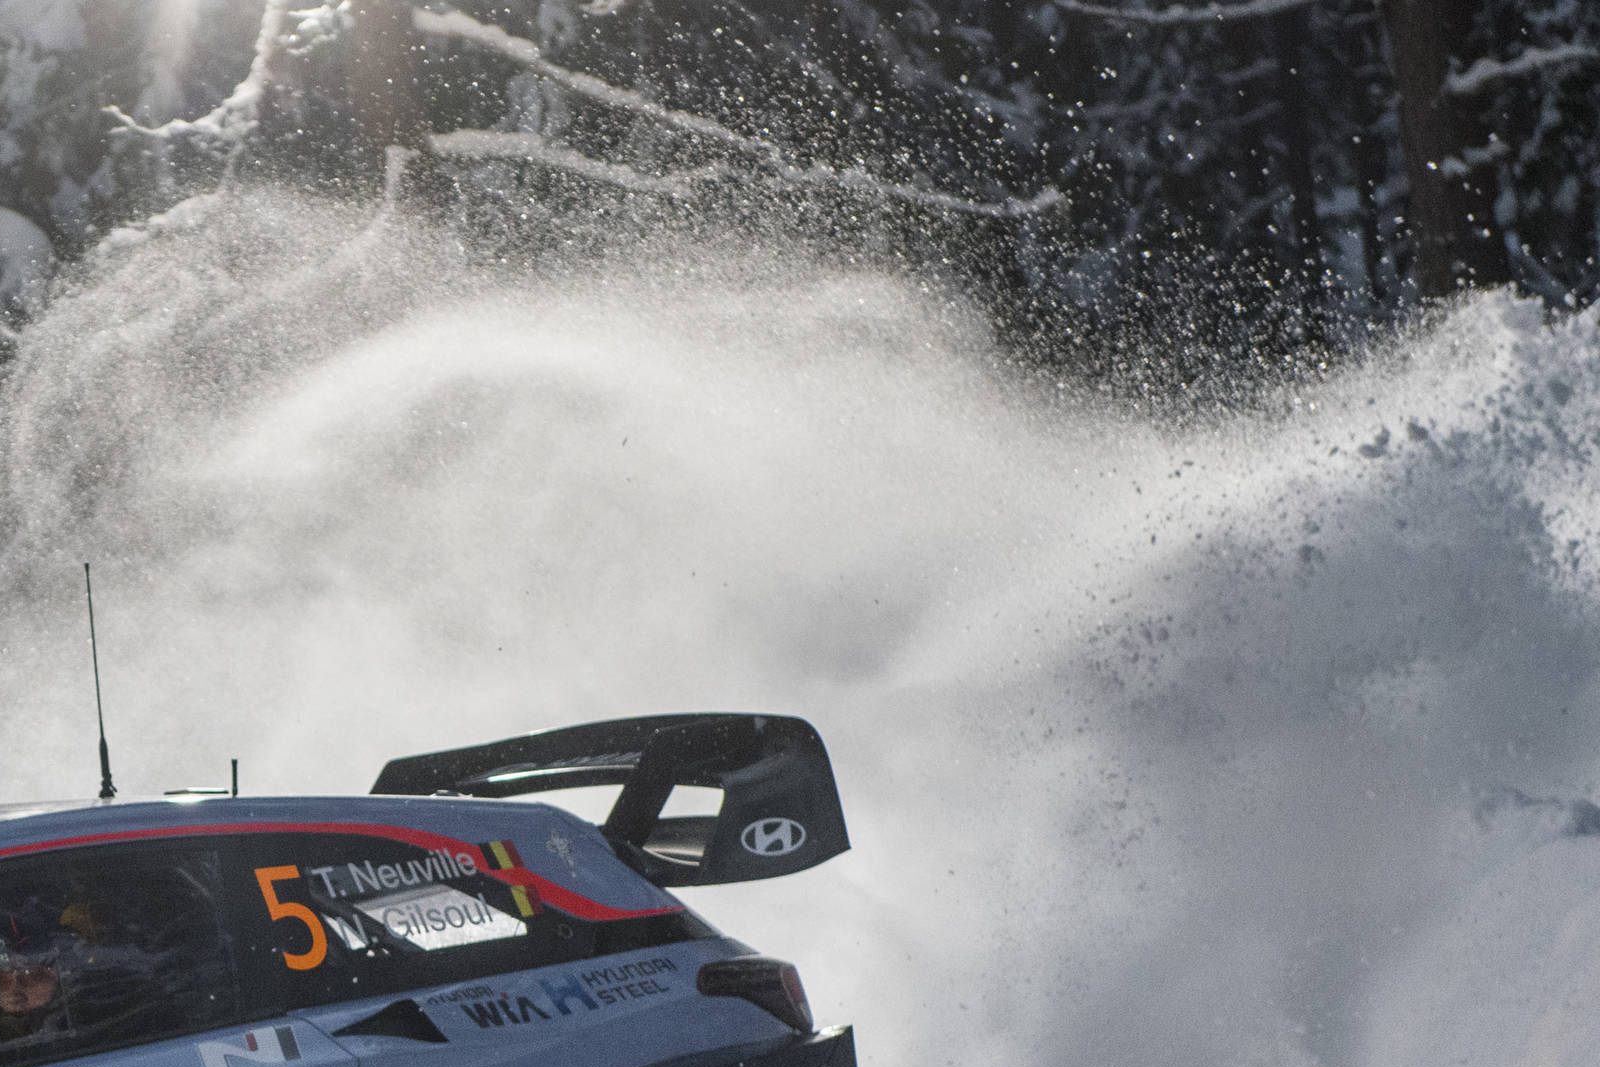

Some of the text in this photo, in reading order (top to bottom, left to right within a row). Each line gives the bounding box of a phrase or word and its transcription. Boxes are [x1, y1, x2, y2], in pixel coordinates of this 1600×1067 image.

[311, 849, 477, 898] T. Neuville
[254, 864, 328, 970] 5
[382, 893, 493, 938] Gilsoul
[581, 957, 679, 988] HYUNDAI
[427, 983, 495, 1006] HYUNDAI
[597, 980, 671, 1006] STEEL
